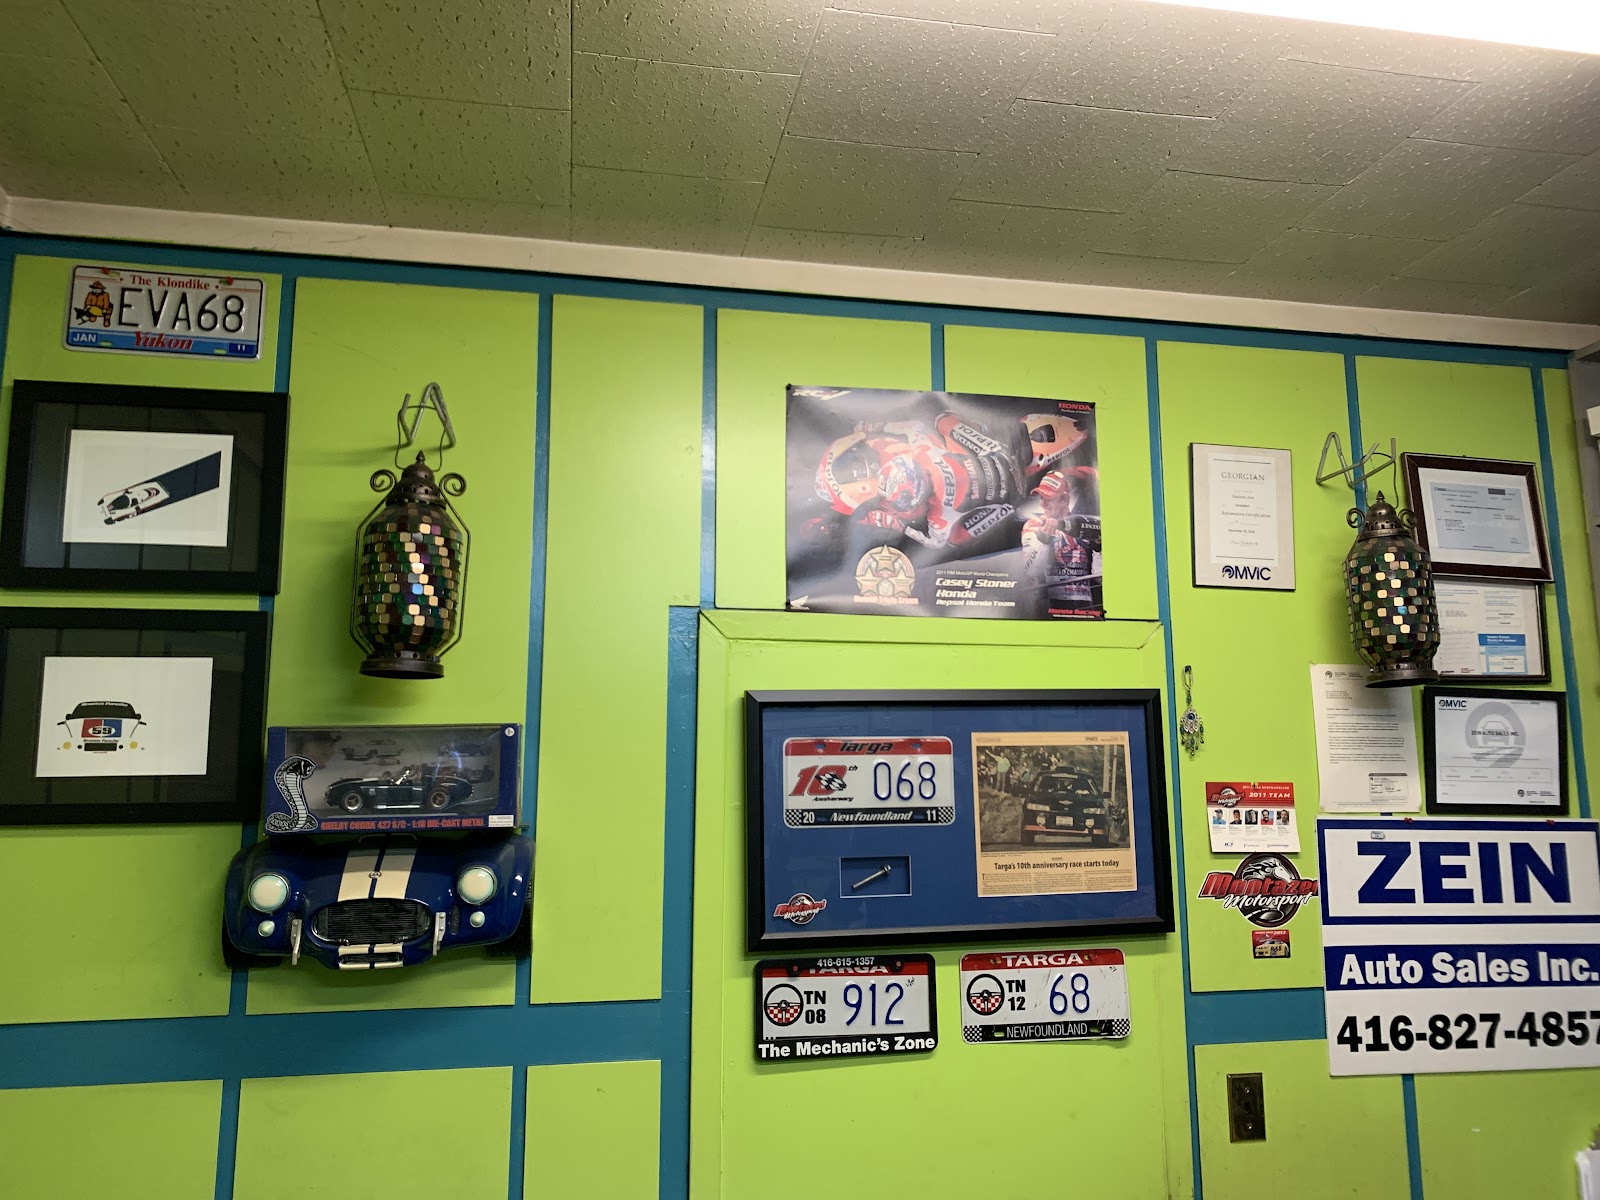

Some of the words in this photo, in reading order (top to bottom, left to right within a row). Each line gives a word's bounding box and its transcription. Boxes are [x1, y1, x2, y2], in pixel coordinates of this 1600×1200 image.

[130, 274, 152, 286] The
[157, 275, 210, 290] Klondike
[118, 287, 245, 333] EVA68
[73, 333, 97, 343] JAN
[133, 331, 193, 350] Yukon
[236, 344, 246, 352] 11
[1058, 402, 1092, 410] HONDA
[1221, 472, 1265, 481] GEORGIAN
[1222, 565, 1272, 581] OMVIC
[935, 577, 973, 589] Casey
[974, 578, 1018, 588] Stoner
[935, 589, 977, 598] Honda
[1438, 699, 1467, 708] OMVIC
[92, 727, 112, 735] 59
[839, 740, 894, 754] Targa
[872, 761, 937, 801] 068
[803, 811, 816, 824] 20
[828, 809, 913, 823] Newfoundland
[925, 809, 936, 820] 11
[321, 821, 348, 831] SHELBY
[349, 820, 375, 830] COBRA
[377, 820, 391, 829] 427
[392, 819, 406, 829] S/C
[426, 818, 460, 828] DIE-CAST
[461, 818, 484, 827] METAL
[993, 862, 1016, 871] Targa's
[1017, 861, 1031, 869] 10th
[1032, 861, 1068, 870] anniversary
[1101, 859, 1120, 868] today
[1357, 841, 1572, 903] ZEIN
[1223, 891, 1313, 910] Motorsport
[817, 956, 875, 967] 416-615-1357
[1001, 952, 1085, 968] TARGA
[1340, 953, 1423, 986] Auto
[1431, 951, 1530, 984] Sales
[1536, 950, 1600, 982] Inc.
[1005, 980, 1026, 994] TN
[1049, 973, 1090, 1015] 68
[804, 990, 827, 1005] TN
[843, 982, 904, 1026] 912
[1007, 997, 1027, 1012] 12
[805, 1009, 827, 1025] 08
[1005, 1022, 1089, 1039] NEWFOUNDLAND
[758, 1042, 790, 1058] The
[795, 1037, 890, 1056] Mechanic's
[893, 1036, 936, 1051] Zone
